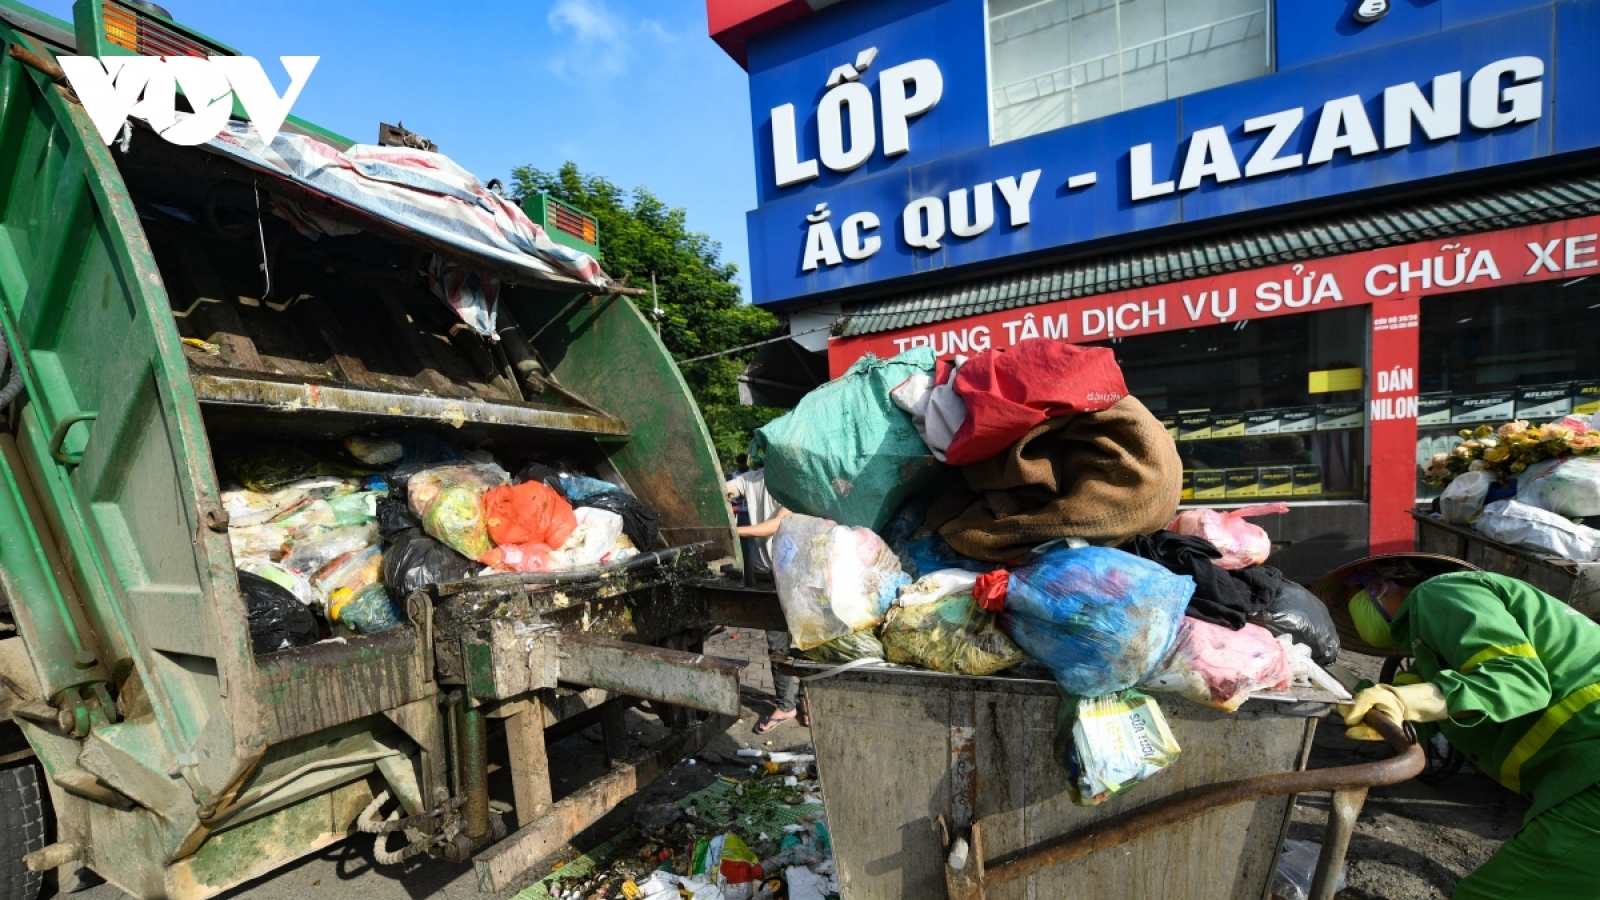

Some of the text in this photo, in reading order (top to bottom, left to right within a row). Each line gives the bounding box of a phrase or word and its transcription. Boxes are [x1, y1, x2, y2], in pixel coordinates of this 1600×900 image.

[771, 47, 943, 188] LỐP
[802, 203, 881, 271] ẮC
[903, 169, 1041, 250] QUY
[1130, 55, 1545, 201] LAZANG
[1002, 312, 1068, 346] TÂM
[1082, 299, 1166, 338] DỊCH
[1183, 288, 1237, 323] VỤ
[1255, 264, 1343, 312] SỬA
[1364, 244, 1501, 297] CHỮA
[1526, 233, 1599, 276] XE
[1371, 396, 1419, 420] NILON
[1377, 365, 1413, 393] DÁN
[1129, 713, 1155, 757] SỮA TƯƠI
